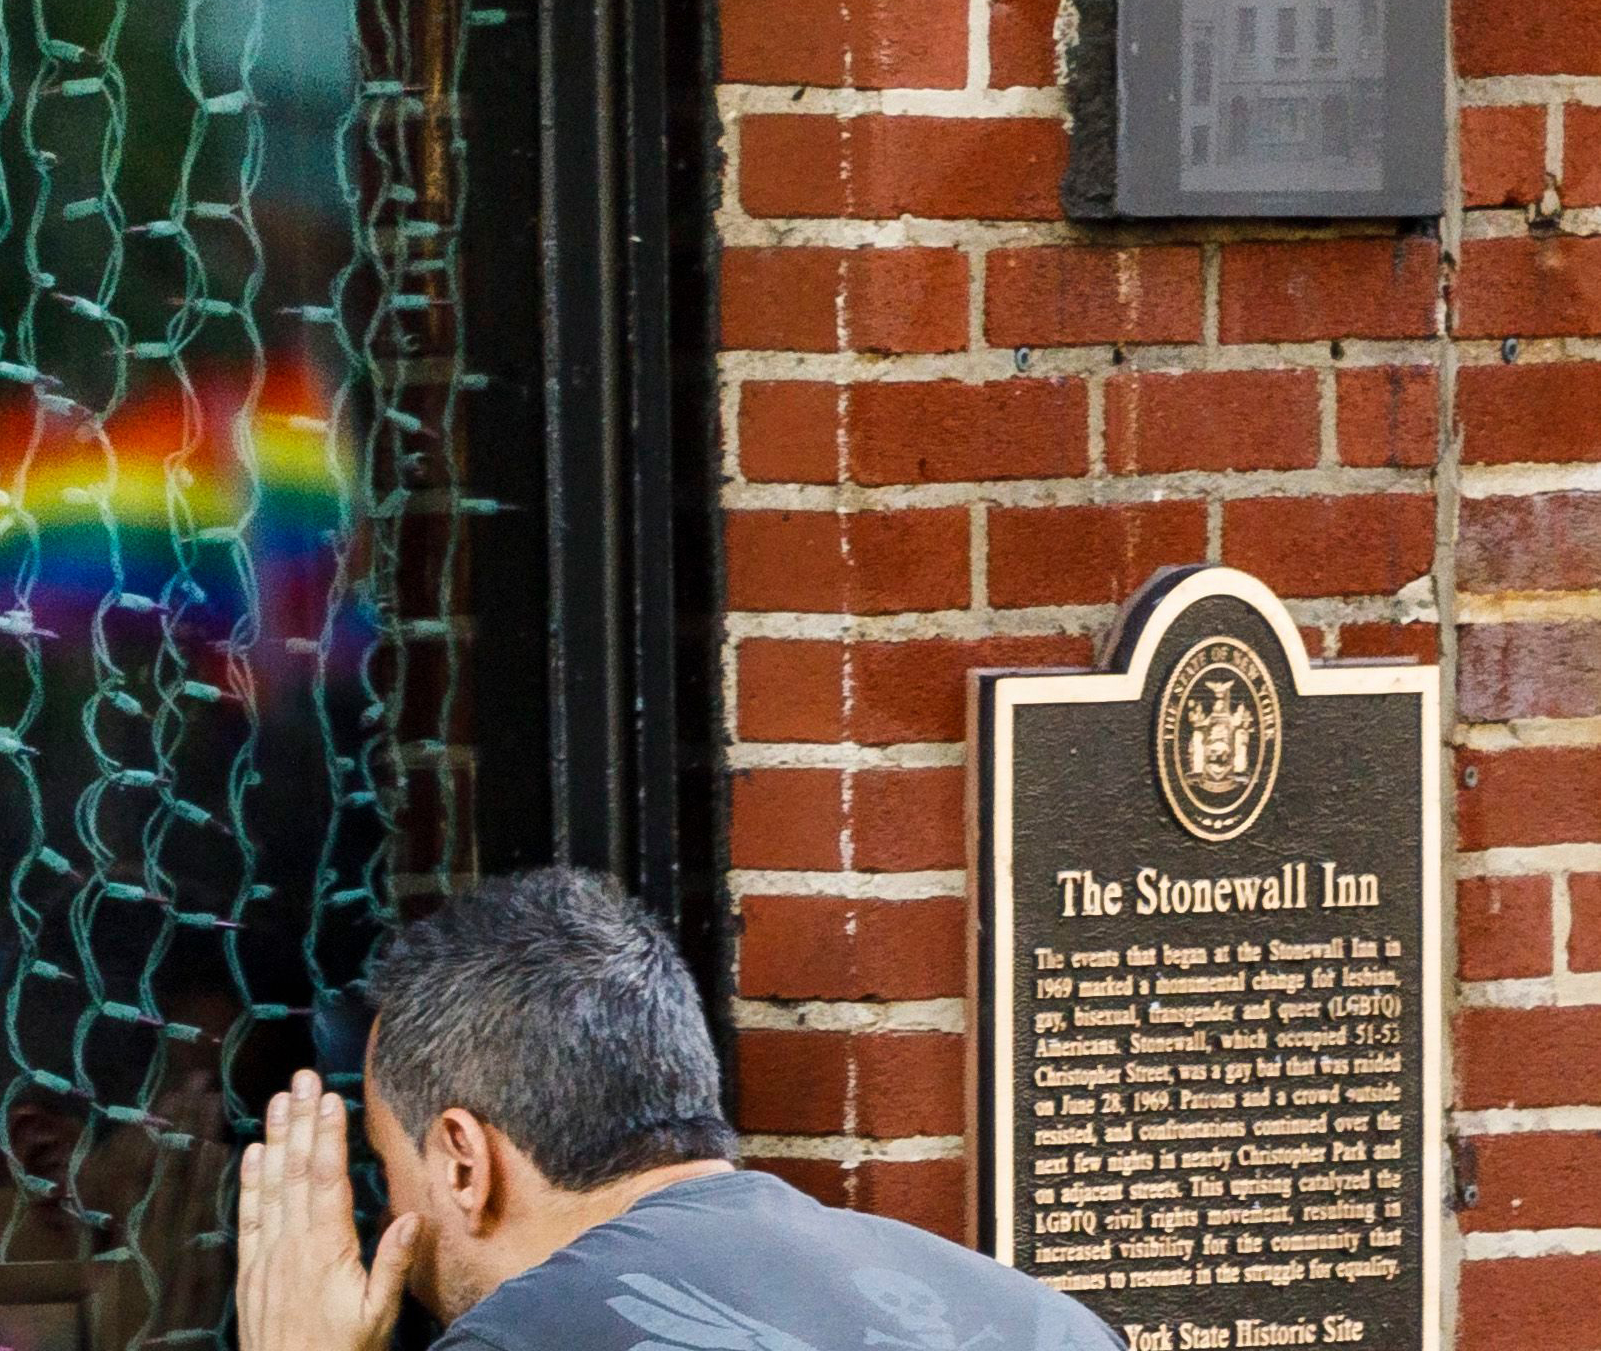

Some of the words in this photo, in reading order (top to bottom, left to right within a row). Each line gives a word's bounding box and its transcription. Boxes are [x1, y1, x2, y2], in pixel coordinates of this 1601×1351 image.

[1211, 646, 1229, 661] OF
[1056, 870, 1122, 918] The
[1136, 863, 1306, 915] Stonewall
[1321, 863, 1379, 909] Inn
[1033, 946, 1065, 970] The
[1070, 949, 1120, 968] events
[1125, 944, 1157, 967] that
[1162, 943, 1208, 970] began
[1213, 944, 1231, 963] at
[1236, 940, 1262, 962] the
[1268, 936, 1345, 961] Stonewall
[1351, 935, 1379, 958] Inn
[1384, 935, 1402, 957] in
[1036, 976, 1074, 999] 1969
[1077, 974, 1135, 998] marked
[1138, 978, 1150, 995] a
[1155, 970, 1246, 995] monumental
[1251, 969, 1306, 994] change
[1311, 966, 1337, 988] for
[1341, 965, 1402, 993] lesbian,
[1033, 1010, 1067, 1034] gay,
[1073, 1004, 1141, 1027] bisexual,
[1148, 1000, 1237, 1027] transgender
[1242, 998, 1272, 1020] and
[1277, 1001, 1323, 1023] queer
[1327, 990, 1403, 1018] (LGBTQ)
[1034, 1035, 1122, 1058] Americans.
[1129, 1030, 1214, 1054] Stonewall,
[1219, 1027, 1268, 1049] which
[1274, 1025, 1348, 1051] occupied
[1033, 1063, 1122, 1090] Christopher
[1124, 1061, 1175, 1083] Street,
[1177, 1063, 1208, 1080] was
[1210, 1063, 1222, 1079] a
[1224, 1061, 1253, 1085] gay
[1255, 1055, 1283, 1077] bar
[1285, 1055, 1317, 1077] that
[1319, 1055, 1350, 1075] was
[1352, 1050, 1402, 1073] raided
[1180, 1322, 1229, 1350] State
[1236, 1318, 1316, 1348] Historic
[1322, 1314, 1363, 1343] Site
